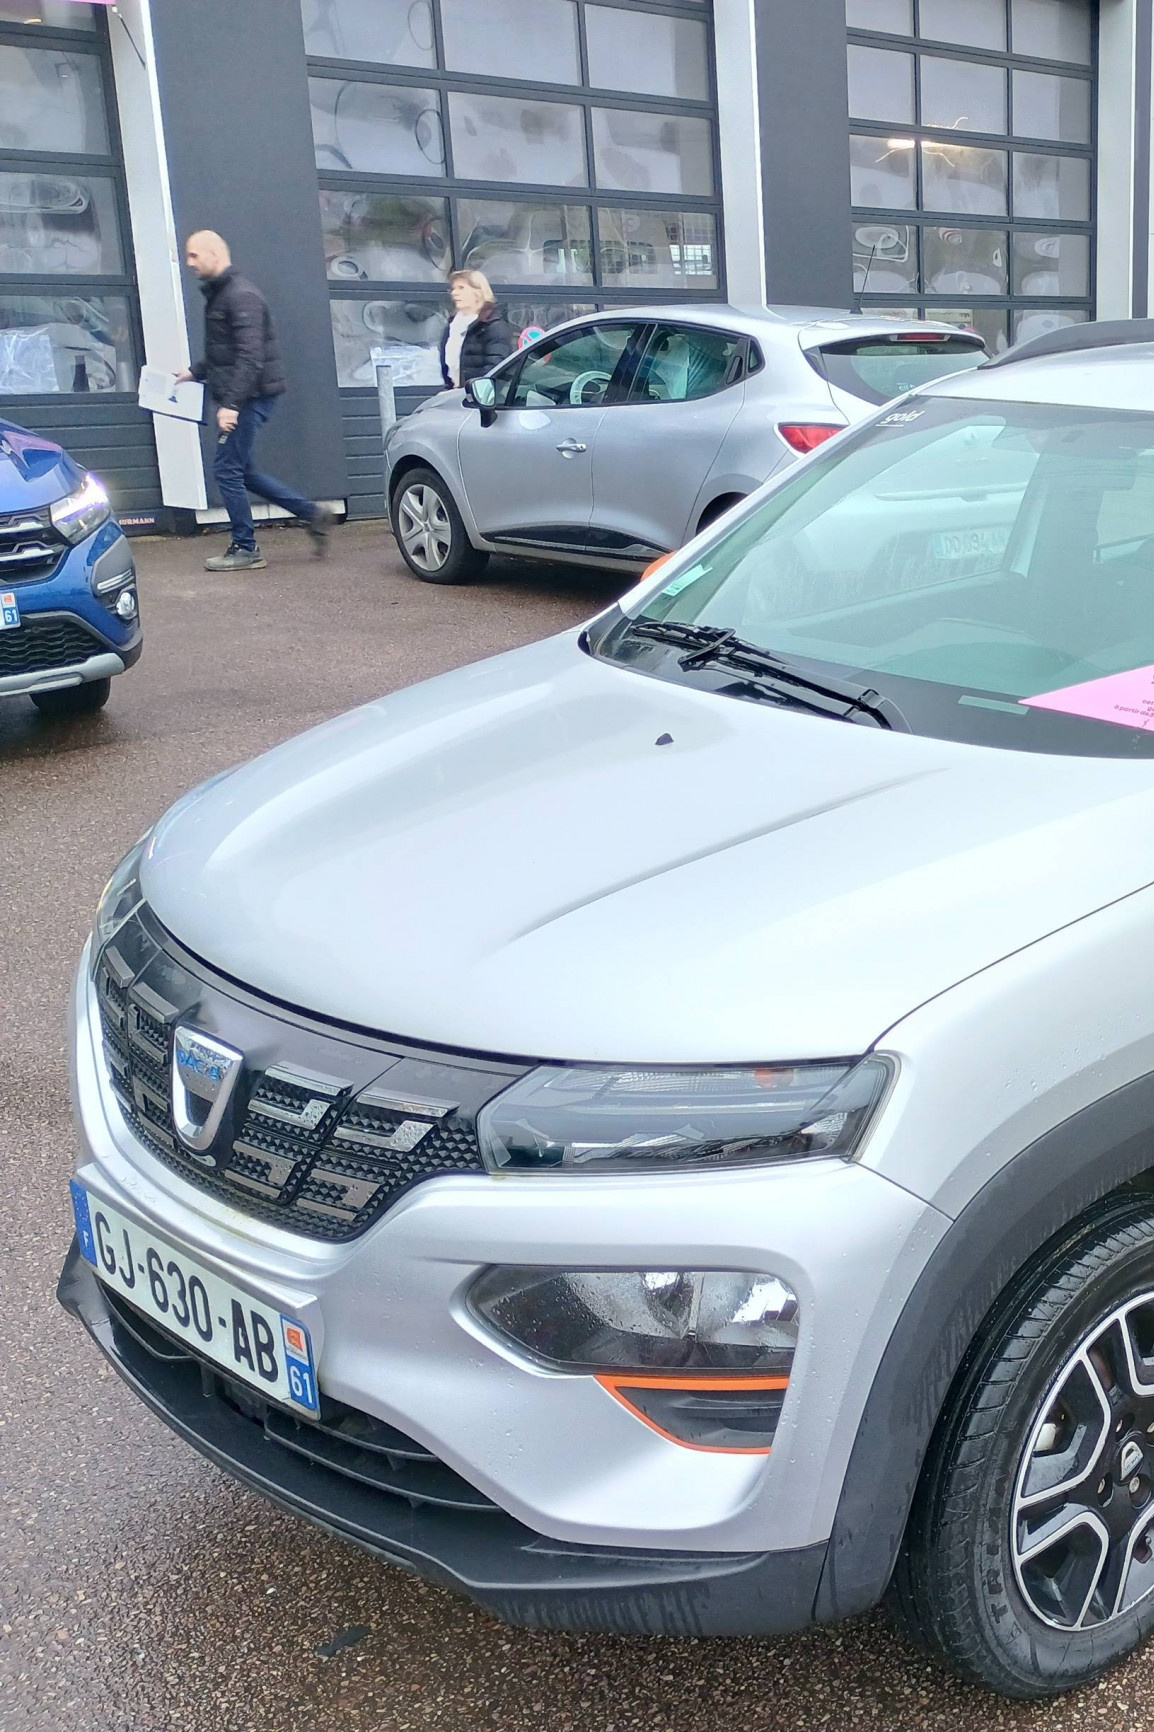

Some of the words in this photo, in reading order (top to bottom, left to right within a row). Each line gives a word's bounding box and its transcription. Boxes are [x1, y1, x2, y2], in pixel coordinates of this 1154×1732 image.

[880, 410, 926, 424] gold
[4, 608, 18, 623] 61
[1118, 706, 1140, 715] partir
[82, 1229, 90, 1248] F
[94, 1210, 279, 1383] GJ-630-AB
[290, 1365, 313, 1404] 61
